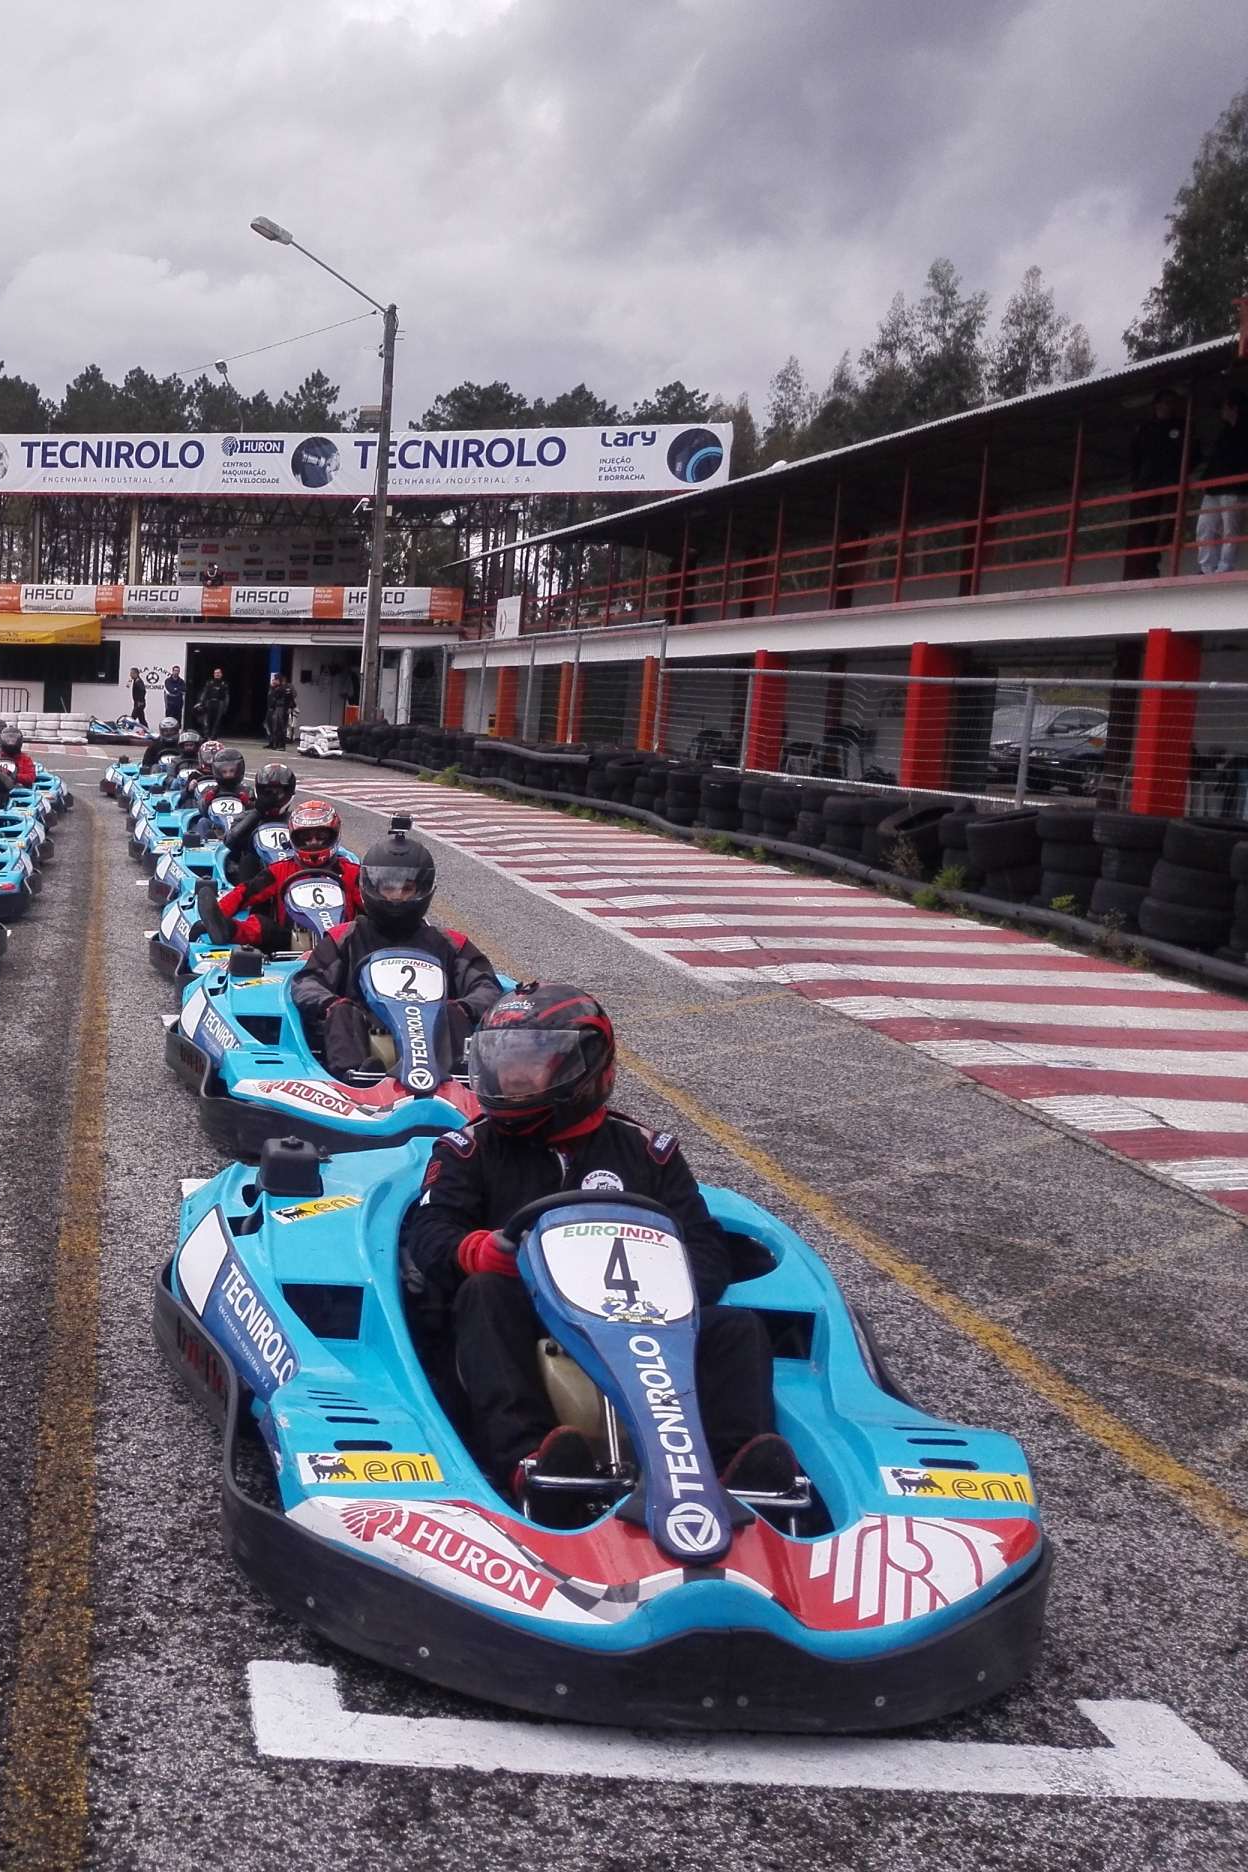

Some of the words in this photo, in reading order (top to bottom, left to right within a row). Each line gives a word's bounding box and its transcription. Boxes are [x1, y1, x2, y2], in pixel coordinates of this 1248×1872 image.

[20, 440, 205, 469] TECNIROLO
[242, 441, 281, 452] HURON
[222, 468, 267, 477] MAQUINAÇÃO
[24, 588, 74, 601] HASCO
[127, 589, 180, 602] HASCO
[235, 590, 290, 603] HASCO
[348, 591, 406, 604] HACO
[220, 801, 235, 813] 24
[312, 887, 325, 905] 6
[380, 959, 434, 969] EUROINDY
[400, 965, 418, 995] 2
[288, 1082, 351, 1114] HURON
[311, 1194, 360, 1213] eni
[563, 1225, 666, 1243] EUROINDY
[603, 1237, 640, 1305] 4
[220, 1262, 294, 1387] TECNIROLO
[628, 1334, 705, 1499] TECNIROLO
[362, 1452, 435, 1483] eni
[951, 1473, 1028, 1504] eni
[411, 1520, 542, 1601] HURON
